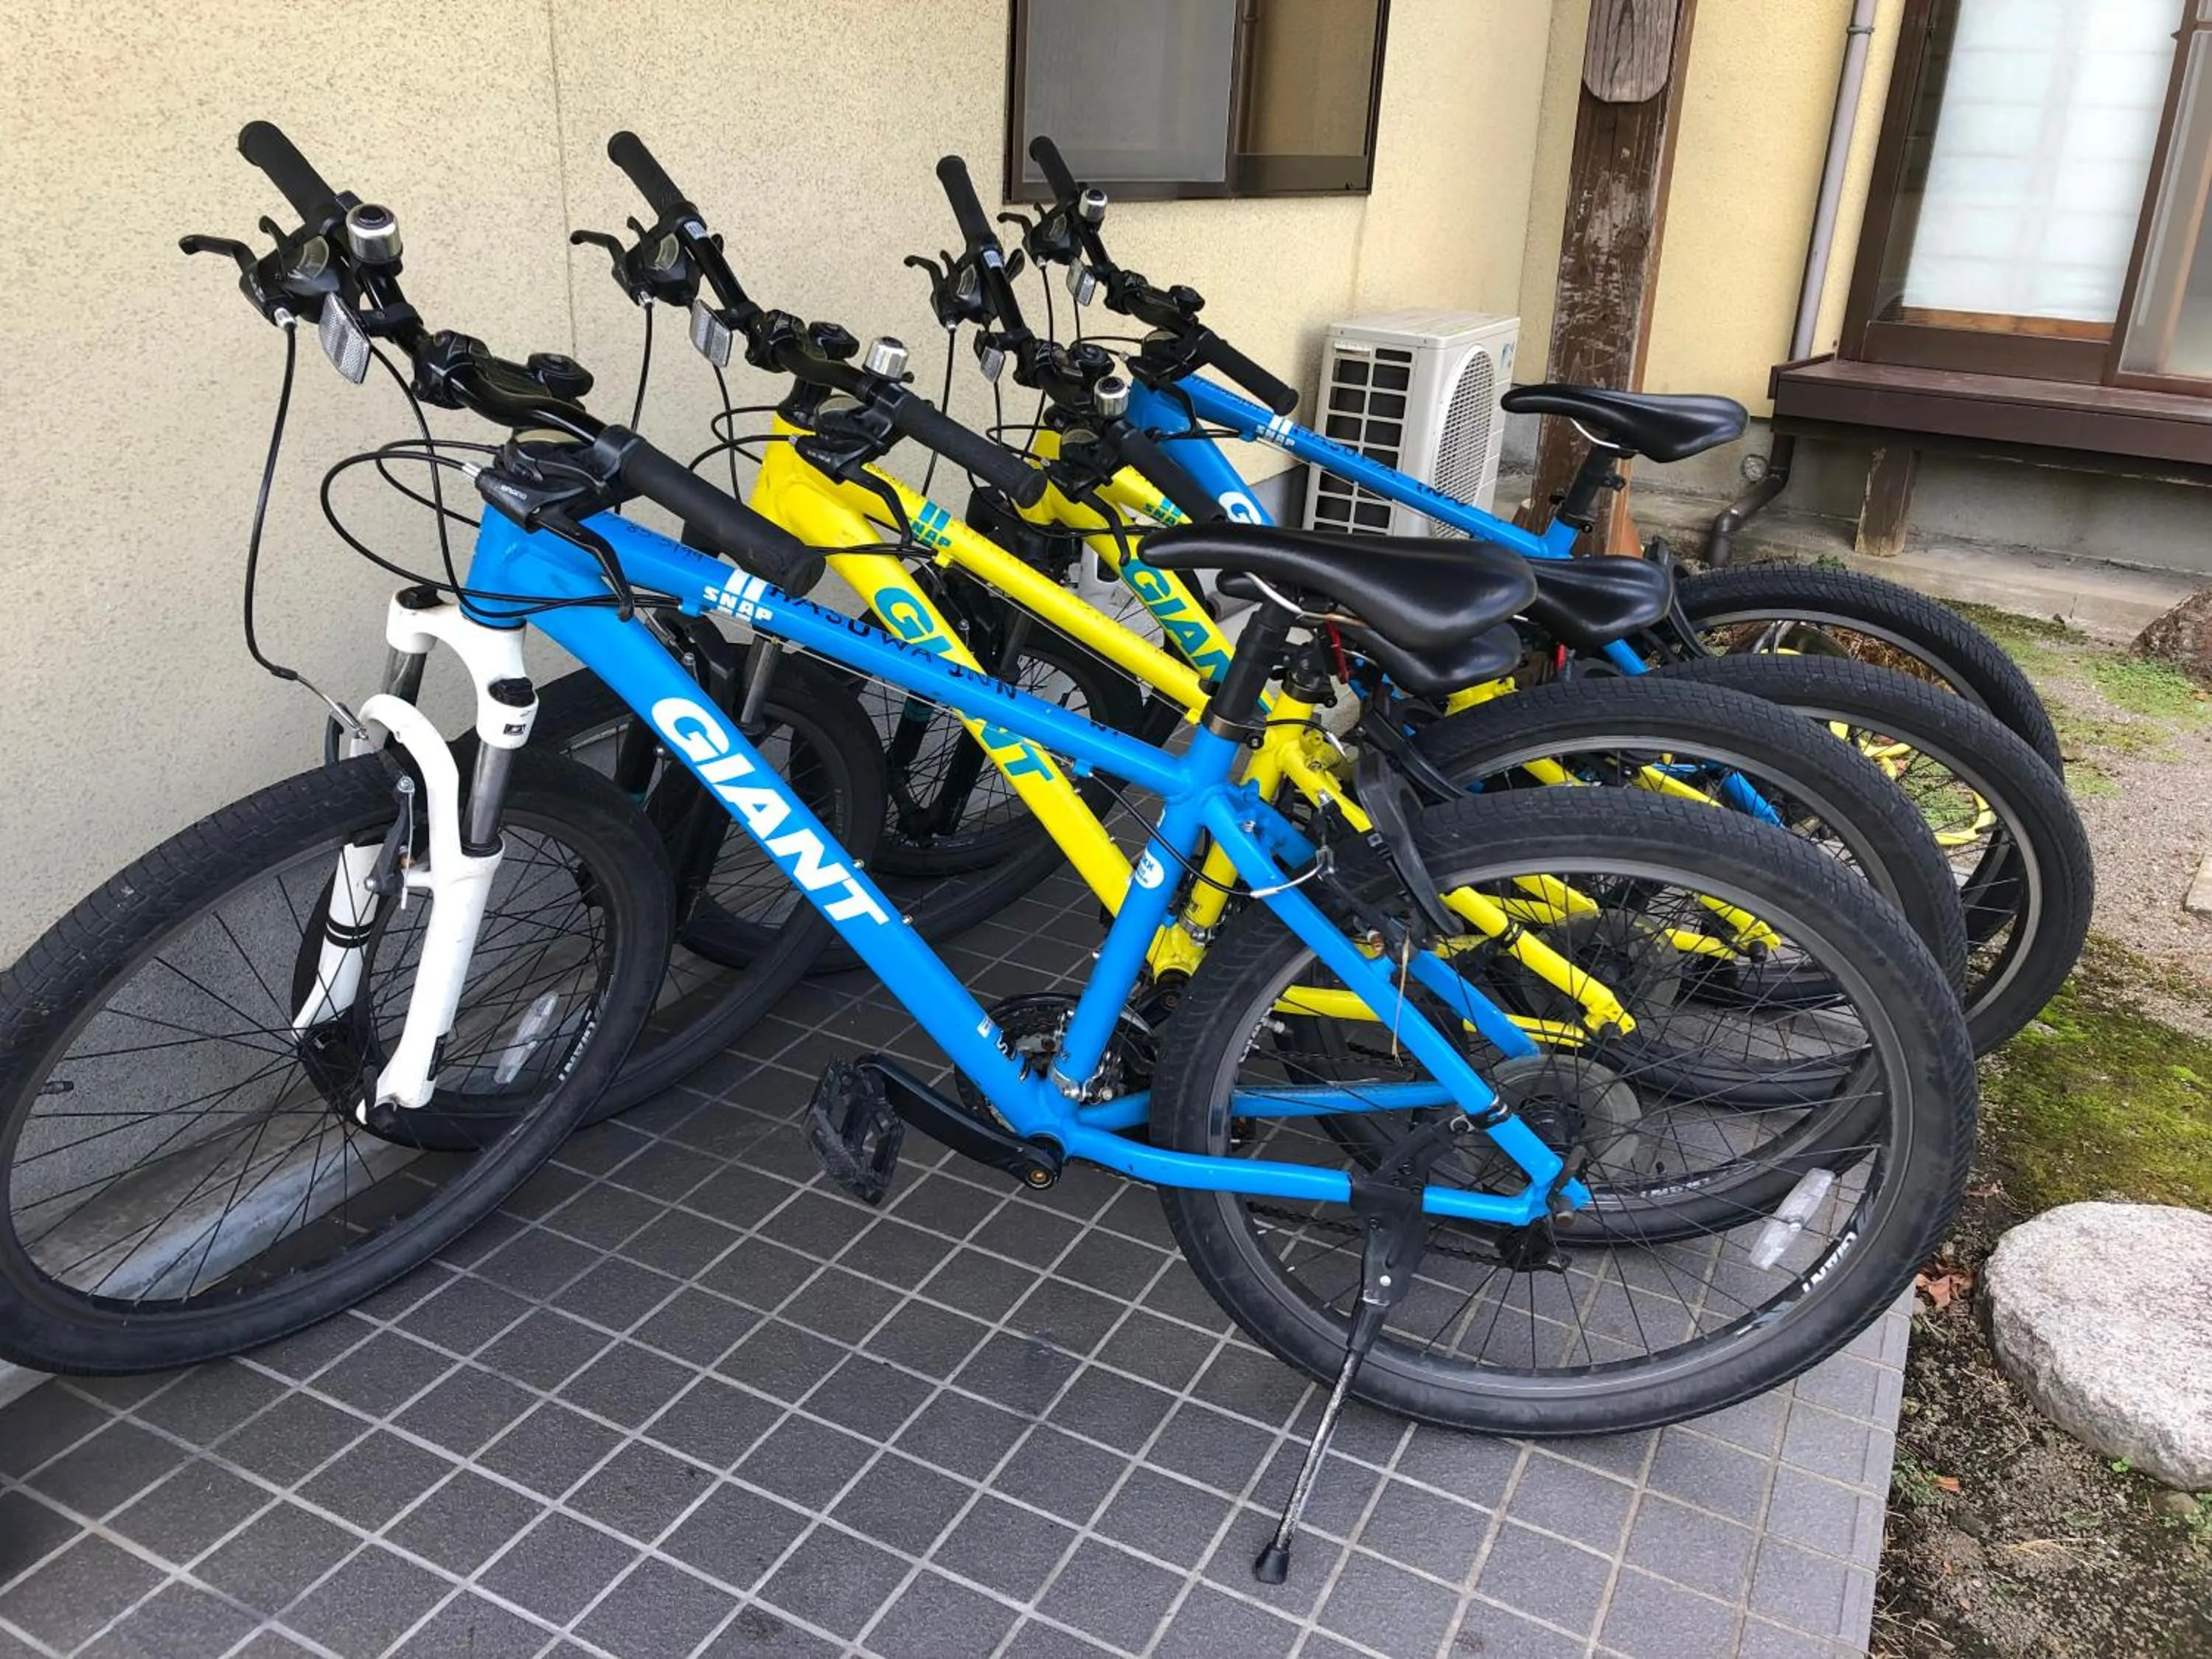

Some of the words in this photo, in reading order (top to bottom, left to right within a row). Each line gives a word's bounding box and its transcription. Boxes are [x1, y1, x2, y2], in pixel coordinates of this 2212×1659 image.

[910, 518, 953, 548] NAP
[703, 585, 773, 622] SNAP
[651, 697, 890, 926] GIANT
